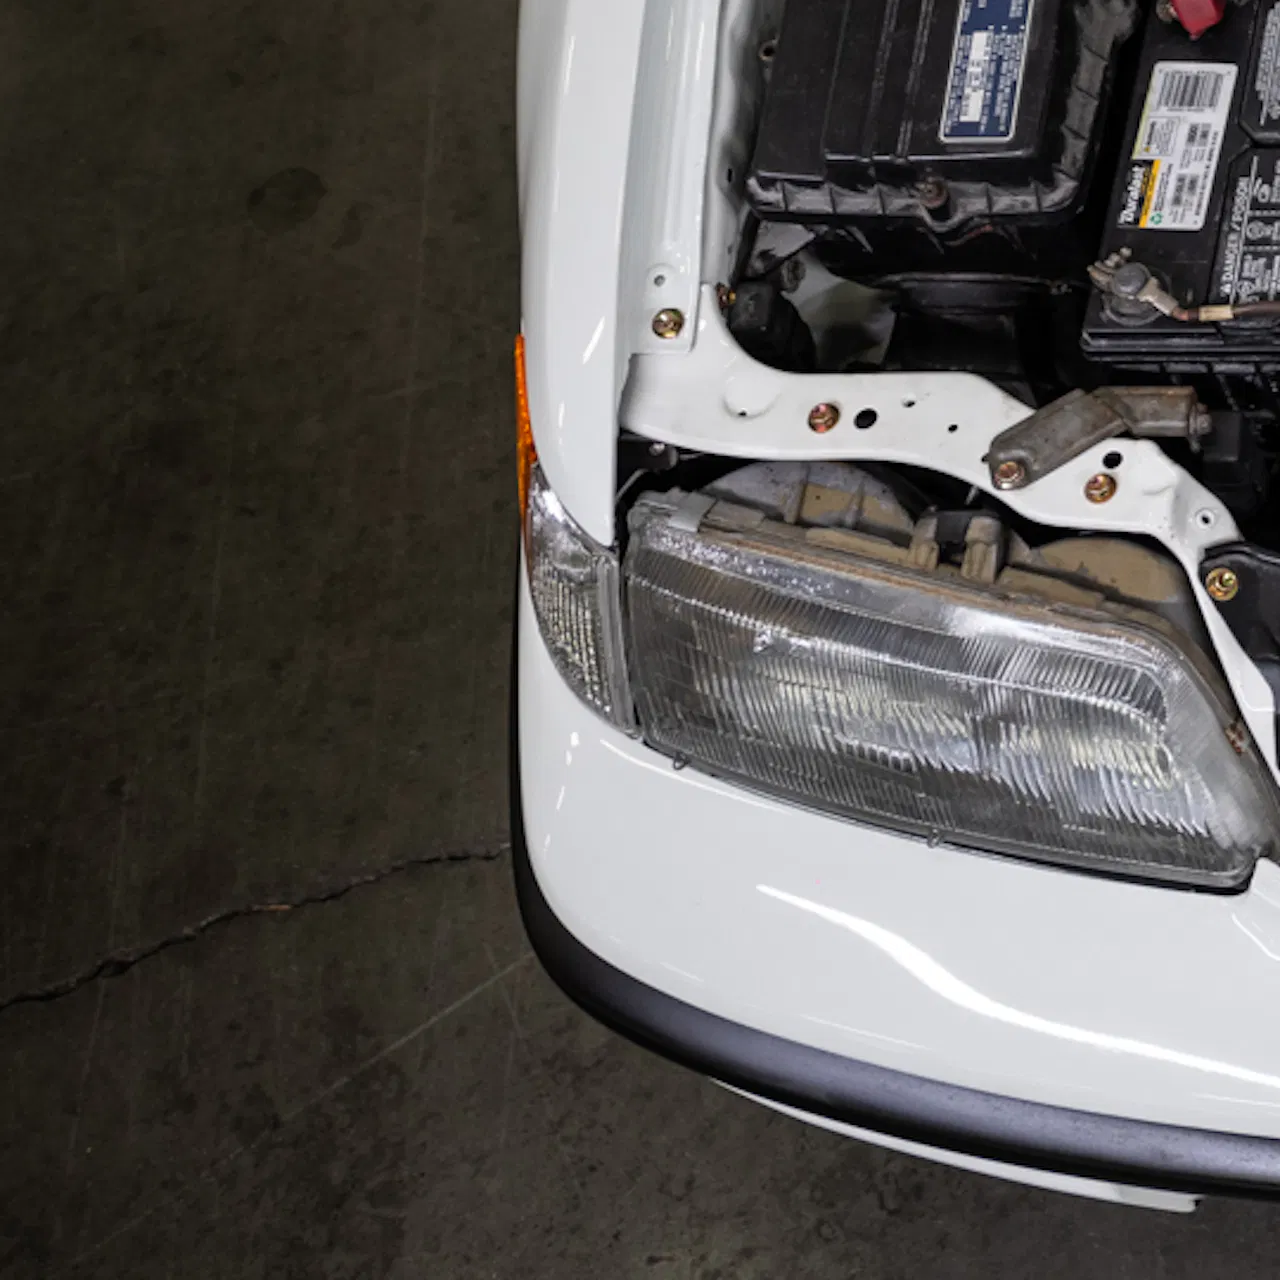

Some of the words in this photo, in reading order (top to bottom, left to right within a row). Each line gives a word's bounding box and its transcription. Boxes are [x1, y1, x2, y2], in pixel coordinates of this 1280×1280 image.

[1118, 165, 1146, 225] Duralast
[1221, 231, 1239, 281] DANGER
[1230, 176, 1251, 221] POISON
